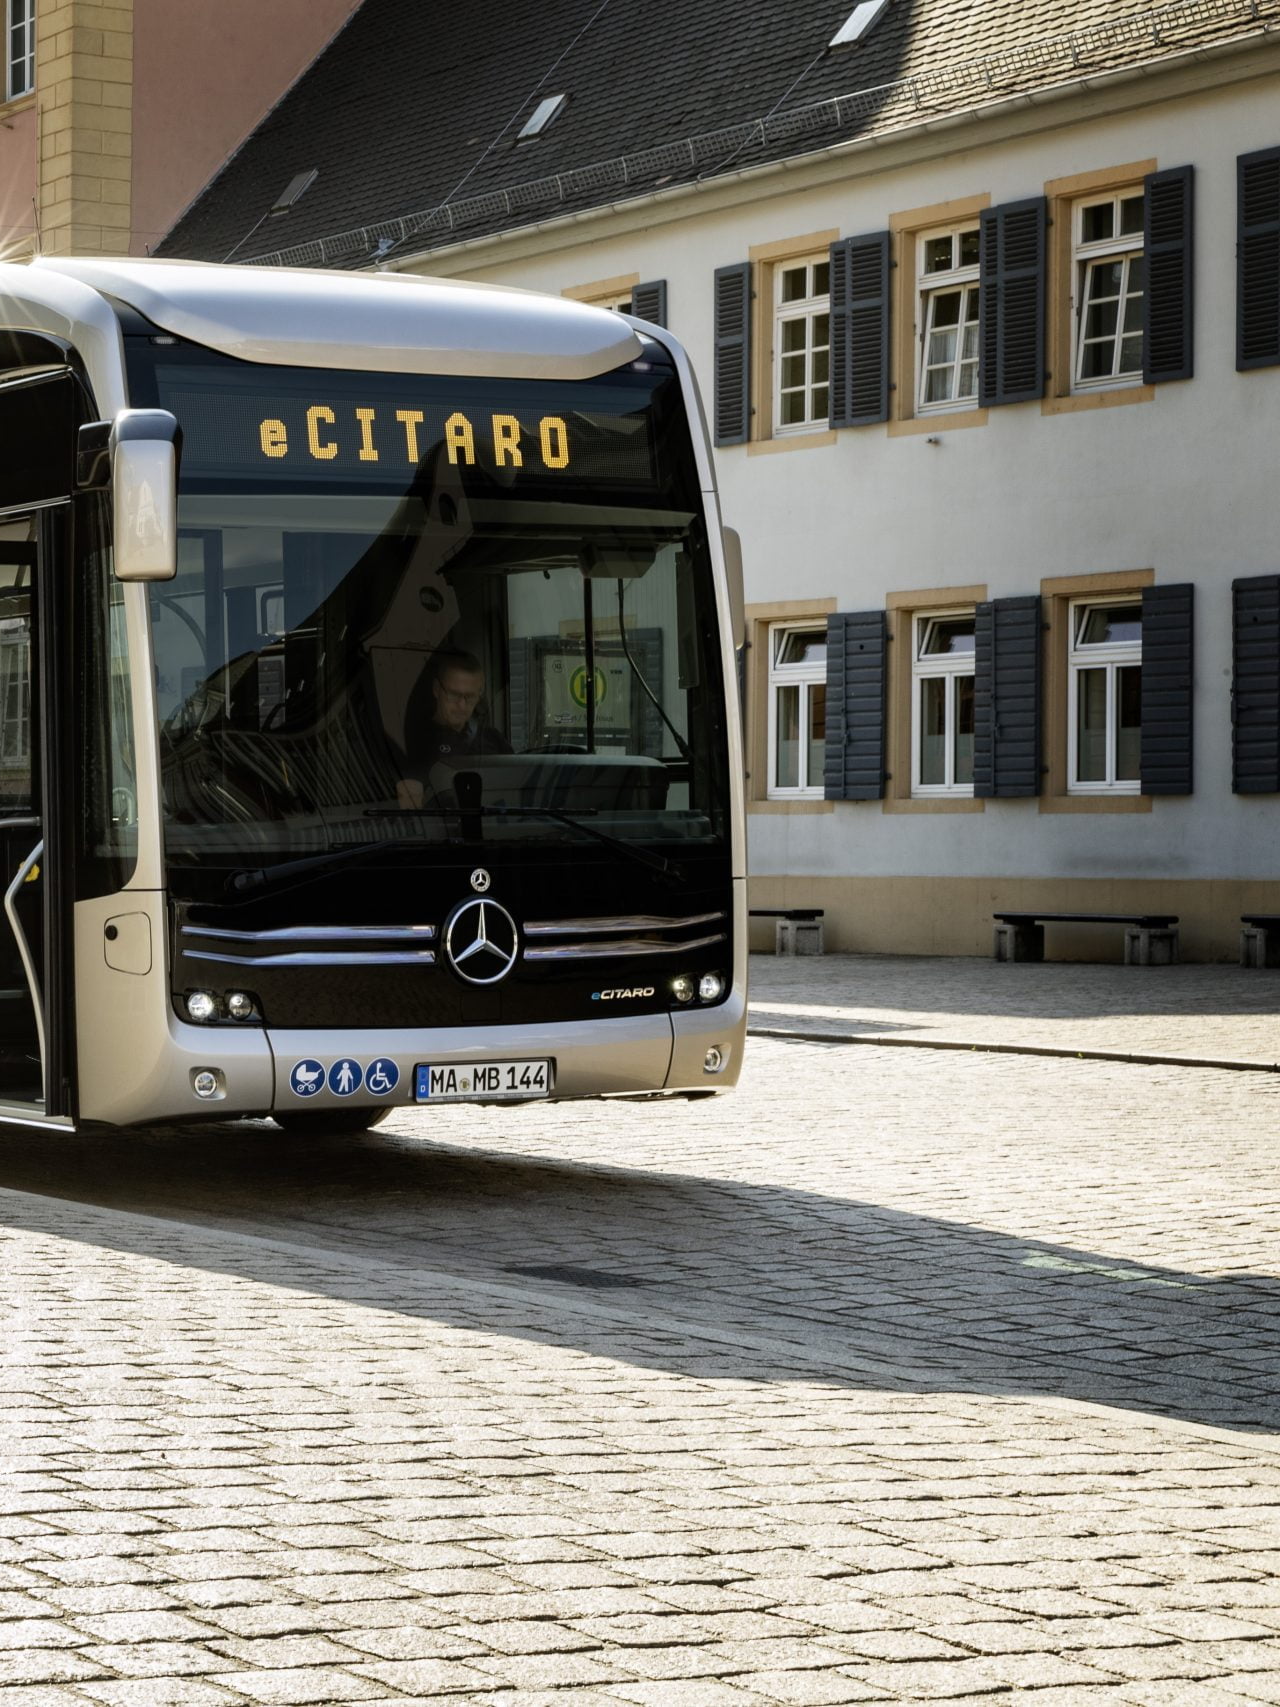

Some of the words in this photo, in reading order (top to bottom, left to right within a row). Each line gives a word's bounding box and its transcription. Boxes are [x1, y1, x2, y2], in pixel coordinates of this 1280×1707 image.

[260, 406, 569, 469] eCITARO
[591, 987, 655, 1000] eCITARO
[420, 1085, 426, 1093] D
[430, 1069, 458, 1094] MA
[473, 1067, 500, 1092] MB
[506, 1065, 545, 1090] 144
